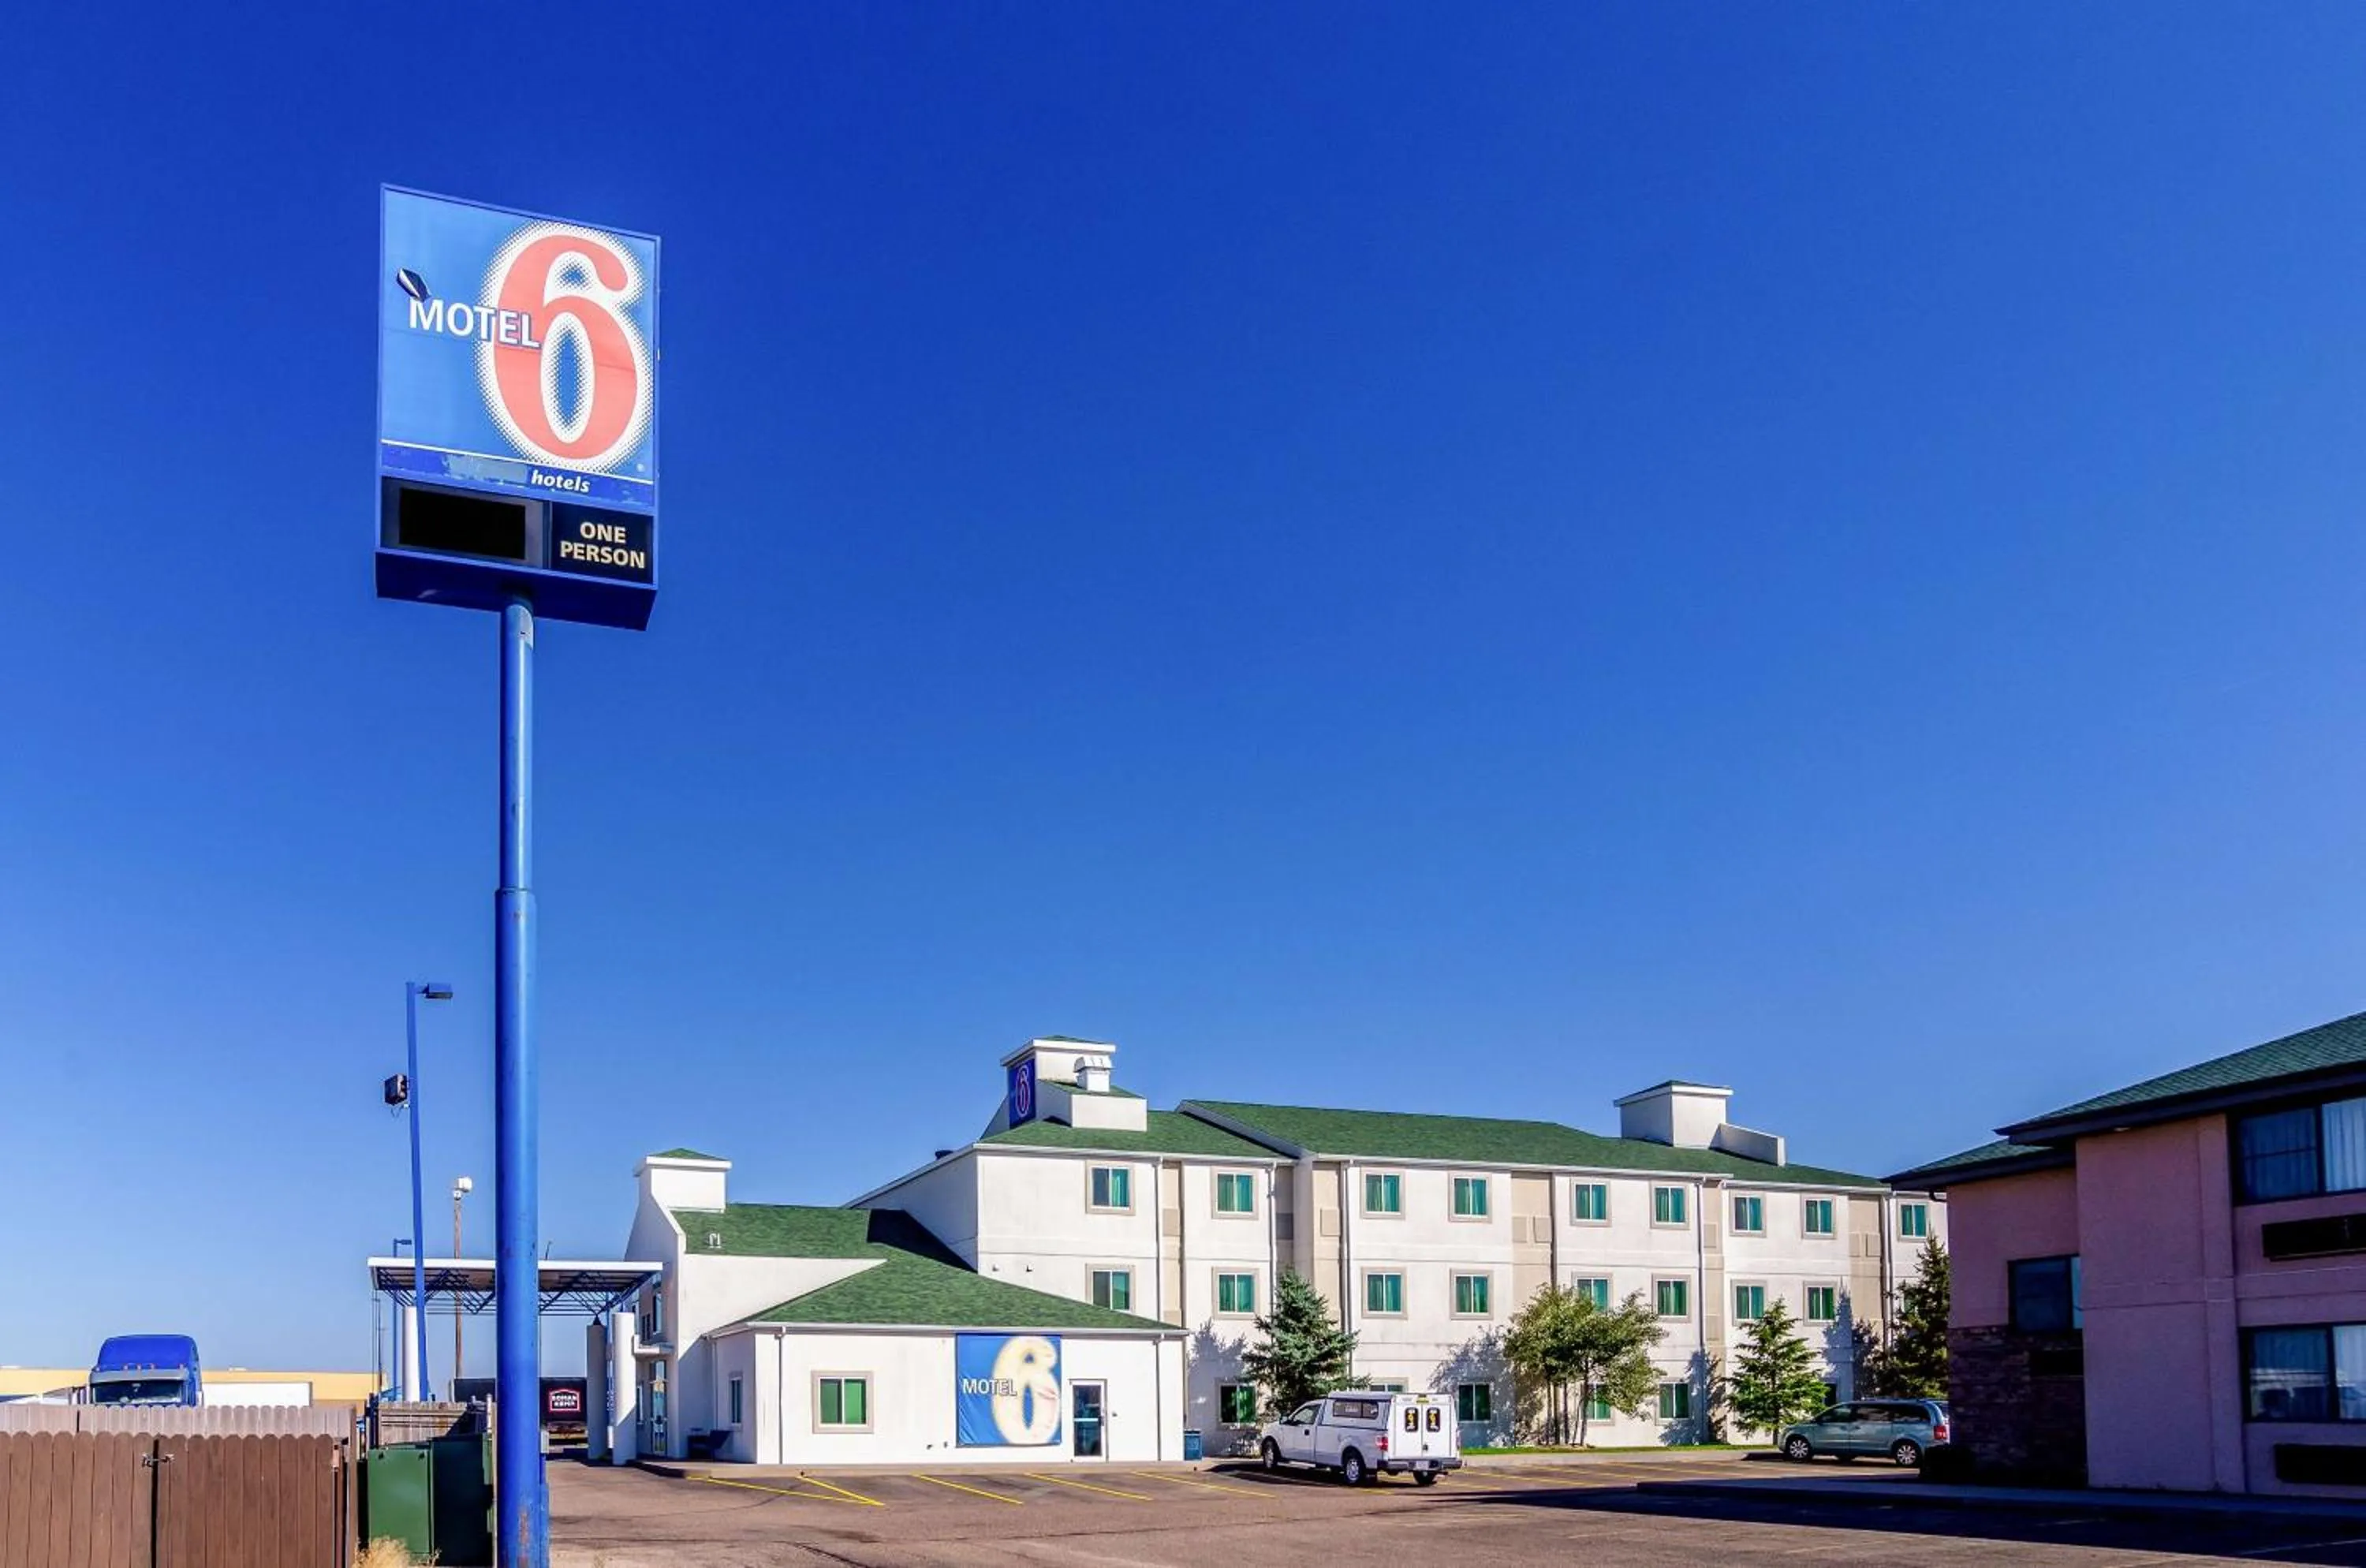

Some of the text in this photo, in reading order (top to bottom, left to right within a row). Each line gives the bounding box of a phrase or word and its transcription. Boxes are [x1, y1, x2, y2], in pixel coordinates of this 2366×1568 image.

[409, 230, 640, 463] MOTEL 6
[531, 469, 591, 493] hotels
[580, 521, 626, 543] ONE
[560, 540, 645, 569] PERSON
[1015, 1065, 1030, 1117] 6
[962, 1335, 1060, 1444] MOTEL 6
